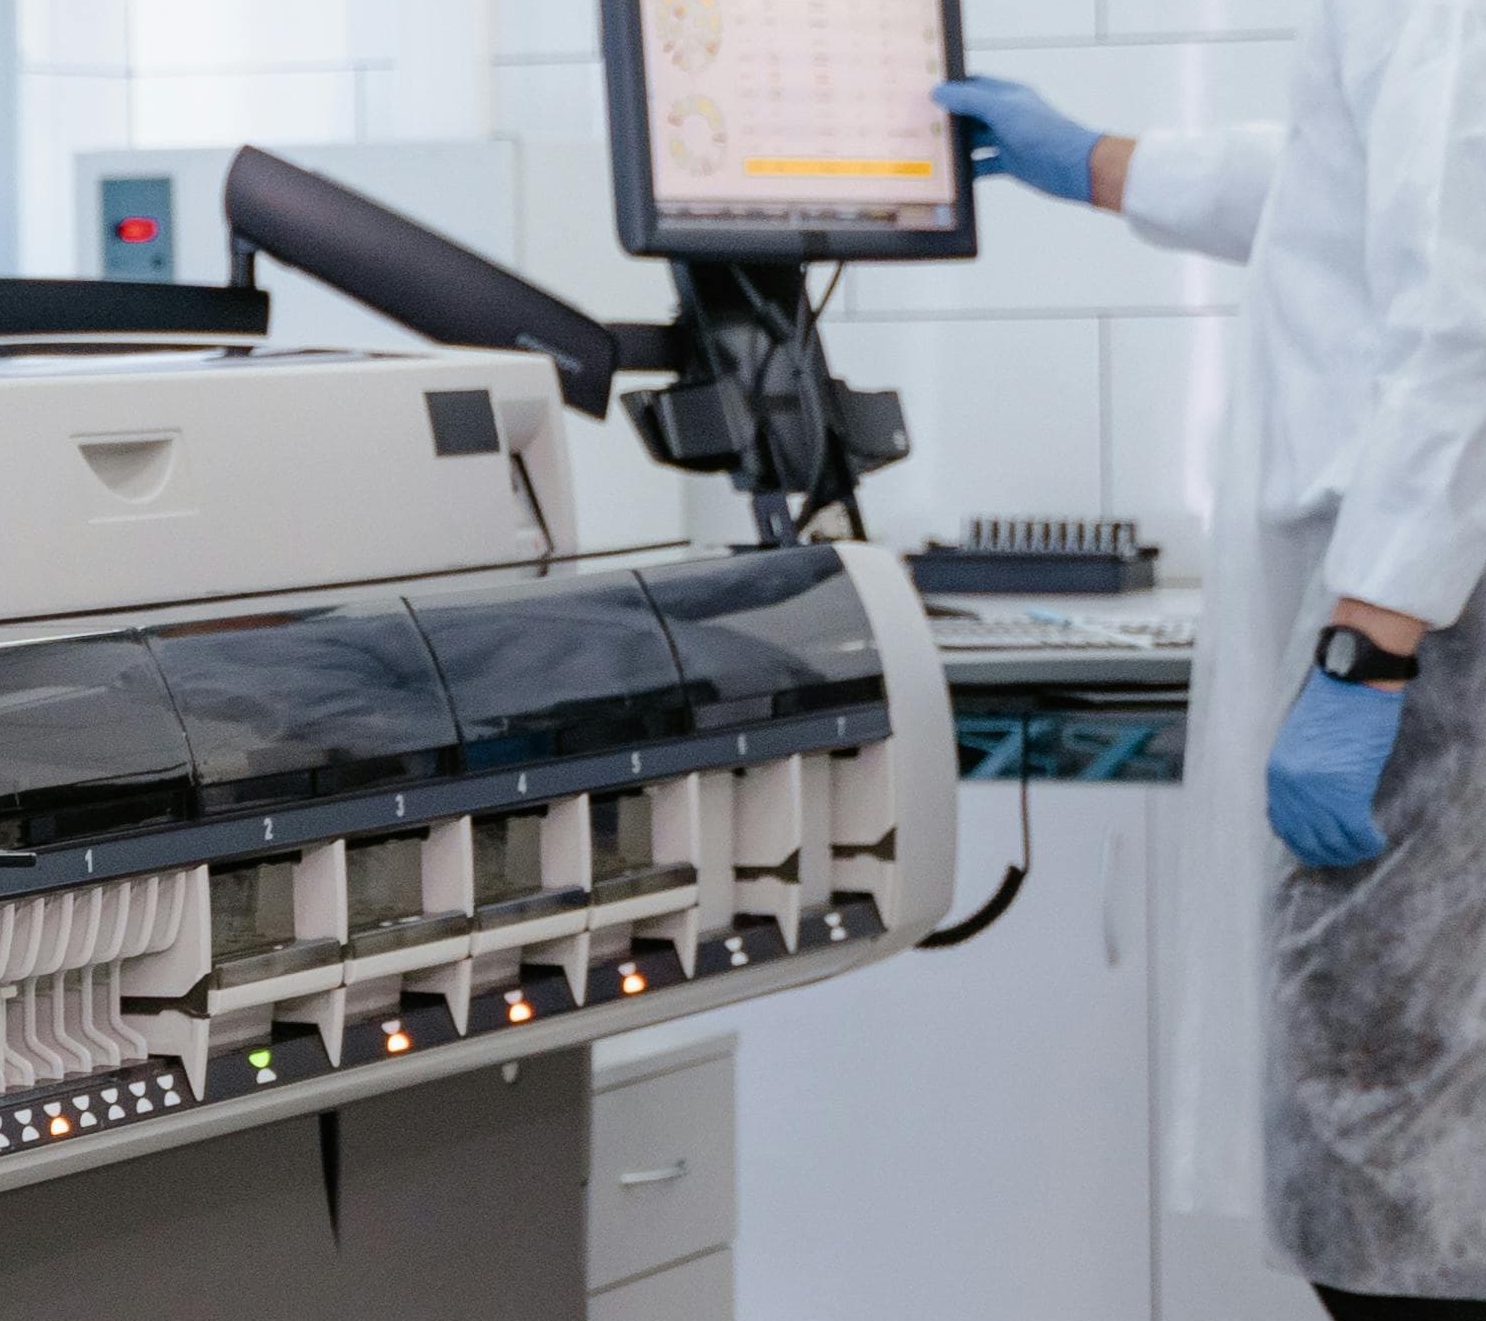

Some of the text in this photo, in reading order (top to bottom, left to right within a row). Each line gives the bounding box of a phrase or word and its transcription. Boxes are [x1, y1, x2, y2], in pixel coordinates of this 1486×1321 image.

[84, 849, 93, 873] 1
[263, 817, 274, 841] 2
[395, 794, 405, 817] 3
[517, 773, 527, 794] 4
[631, 752, 642, 774] 5
